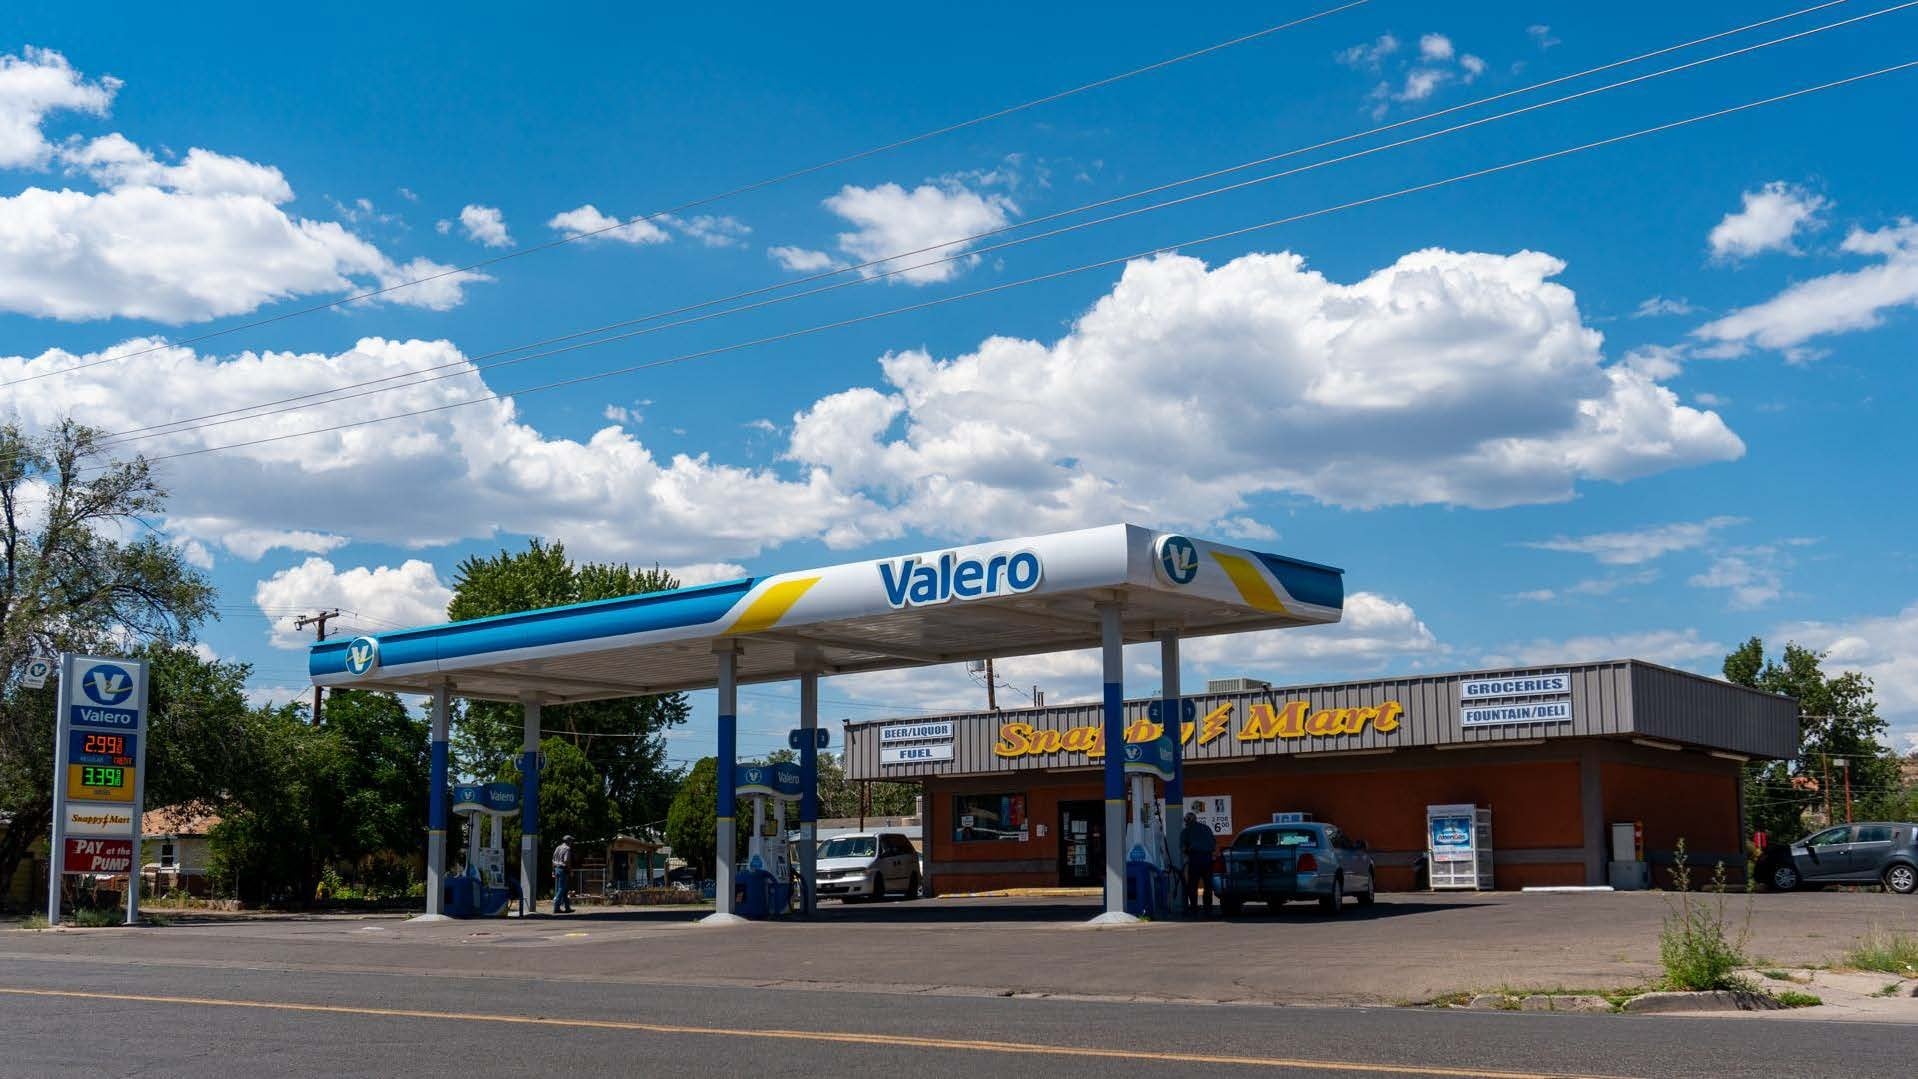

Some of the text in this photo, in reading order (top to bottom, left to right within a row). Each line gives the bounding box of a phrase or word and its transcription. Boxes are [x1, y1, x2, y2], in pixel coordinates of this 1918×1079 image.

[879, 552, 1039, 606] Valero
[1467, 678, 1563, 695] GROCERIES
[80, 708, 131, 724] Valero
[1466, 705, 1566, 721] FOUNTAIN/DELI
[884, 725, 948, 739] BEER/LIQUOR
[995, 718, 1197, 758] Snap
[1236, 700, 1402, 741] Mart
[900, 748, 934, 759] FUEL
[777, 771, 800, 784] Valero
[489, 790, 515, 802] Valero
[72, 813, 131, 825] Snappy Mart
[73, 840, 104, 854] PAY
[117, 846, 131, 856] the
[91, 856, 130, 871] PUMP
